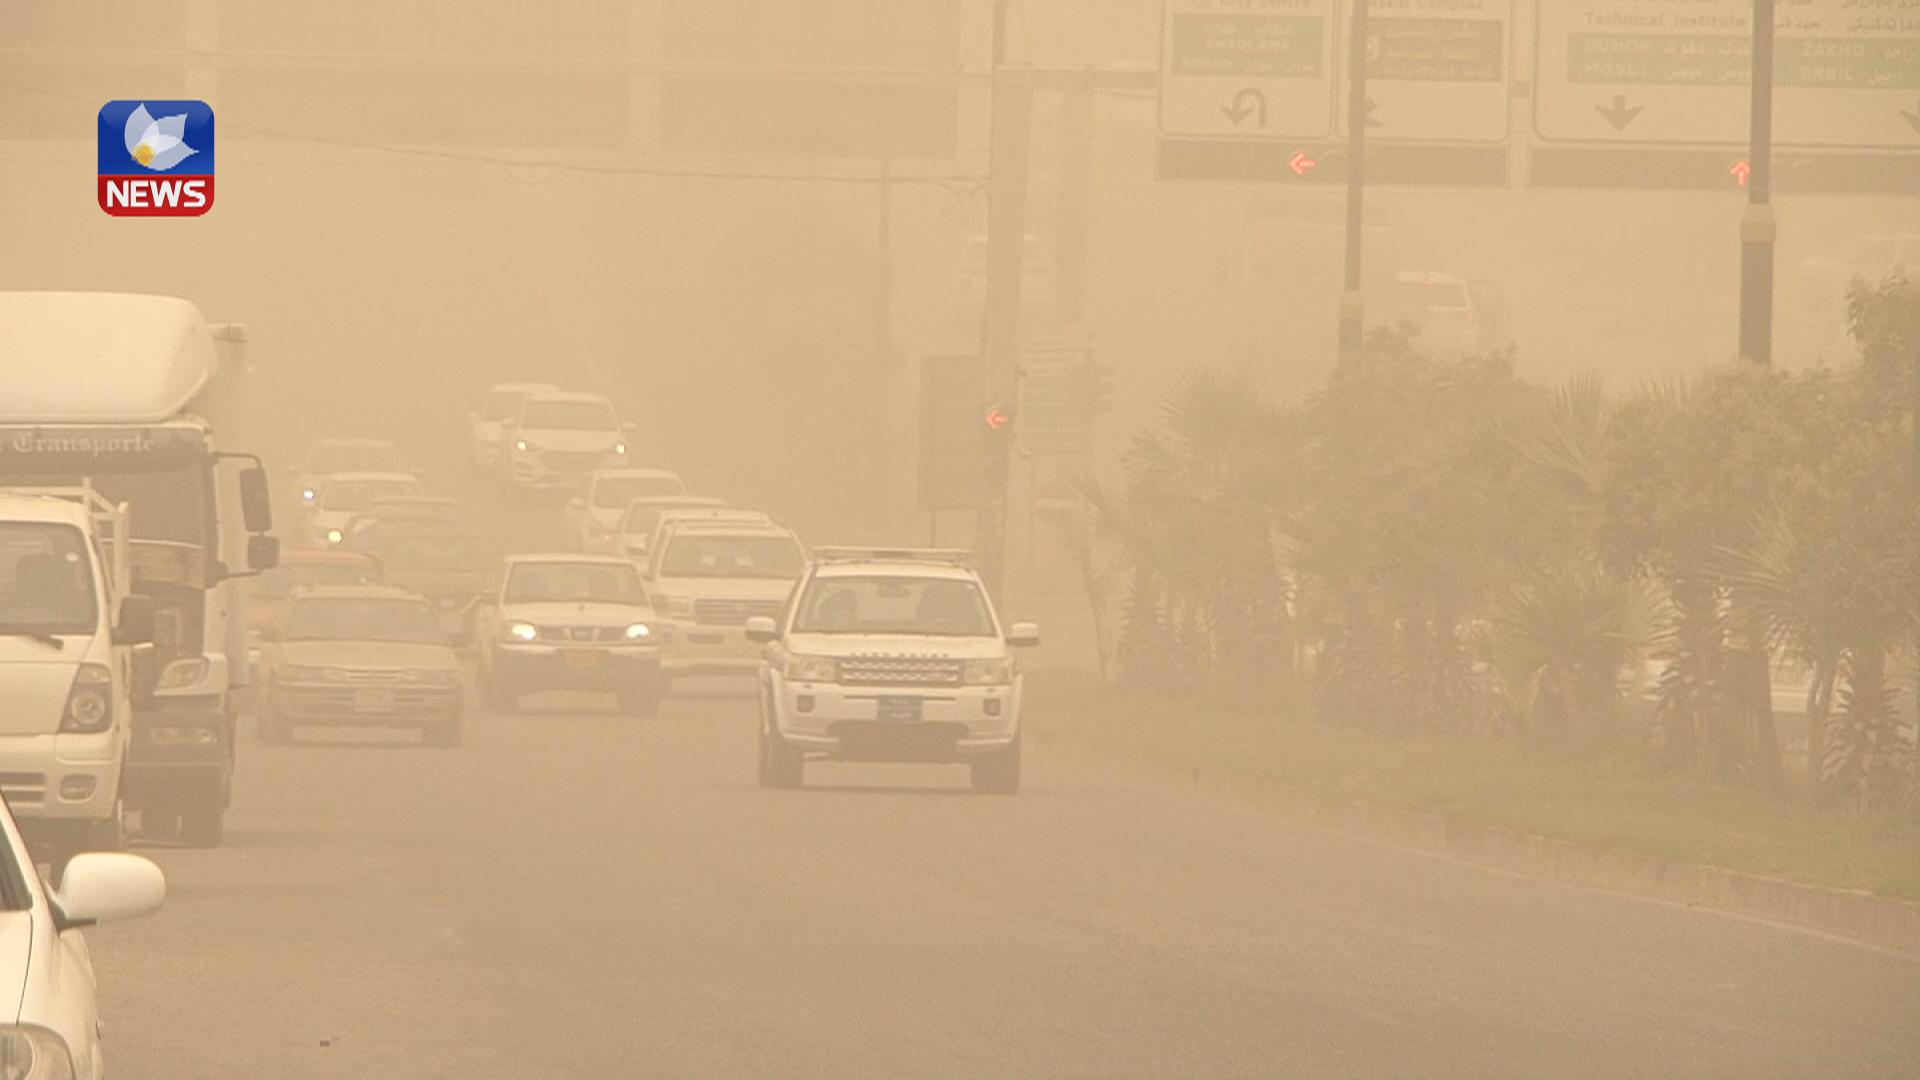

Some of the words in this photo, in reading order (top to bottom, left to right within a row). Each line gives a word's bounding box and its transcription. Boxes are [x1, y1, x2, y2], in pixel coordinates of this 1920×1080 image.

[1584, 11, 1664, 26] Technical
[1673, 12, 1746, 27] Institute
[1584, 38, 1650, 54] DUHOK
[1801, 41, 1865, 57] ZAKHO
[1583, 61, 1649, 77] MOSUL
[1800, 66, 1854, 81] ERBIL
[13, 430, 156, 457] Transporte
